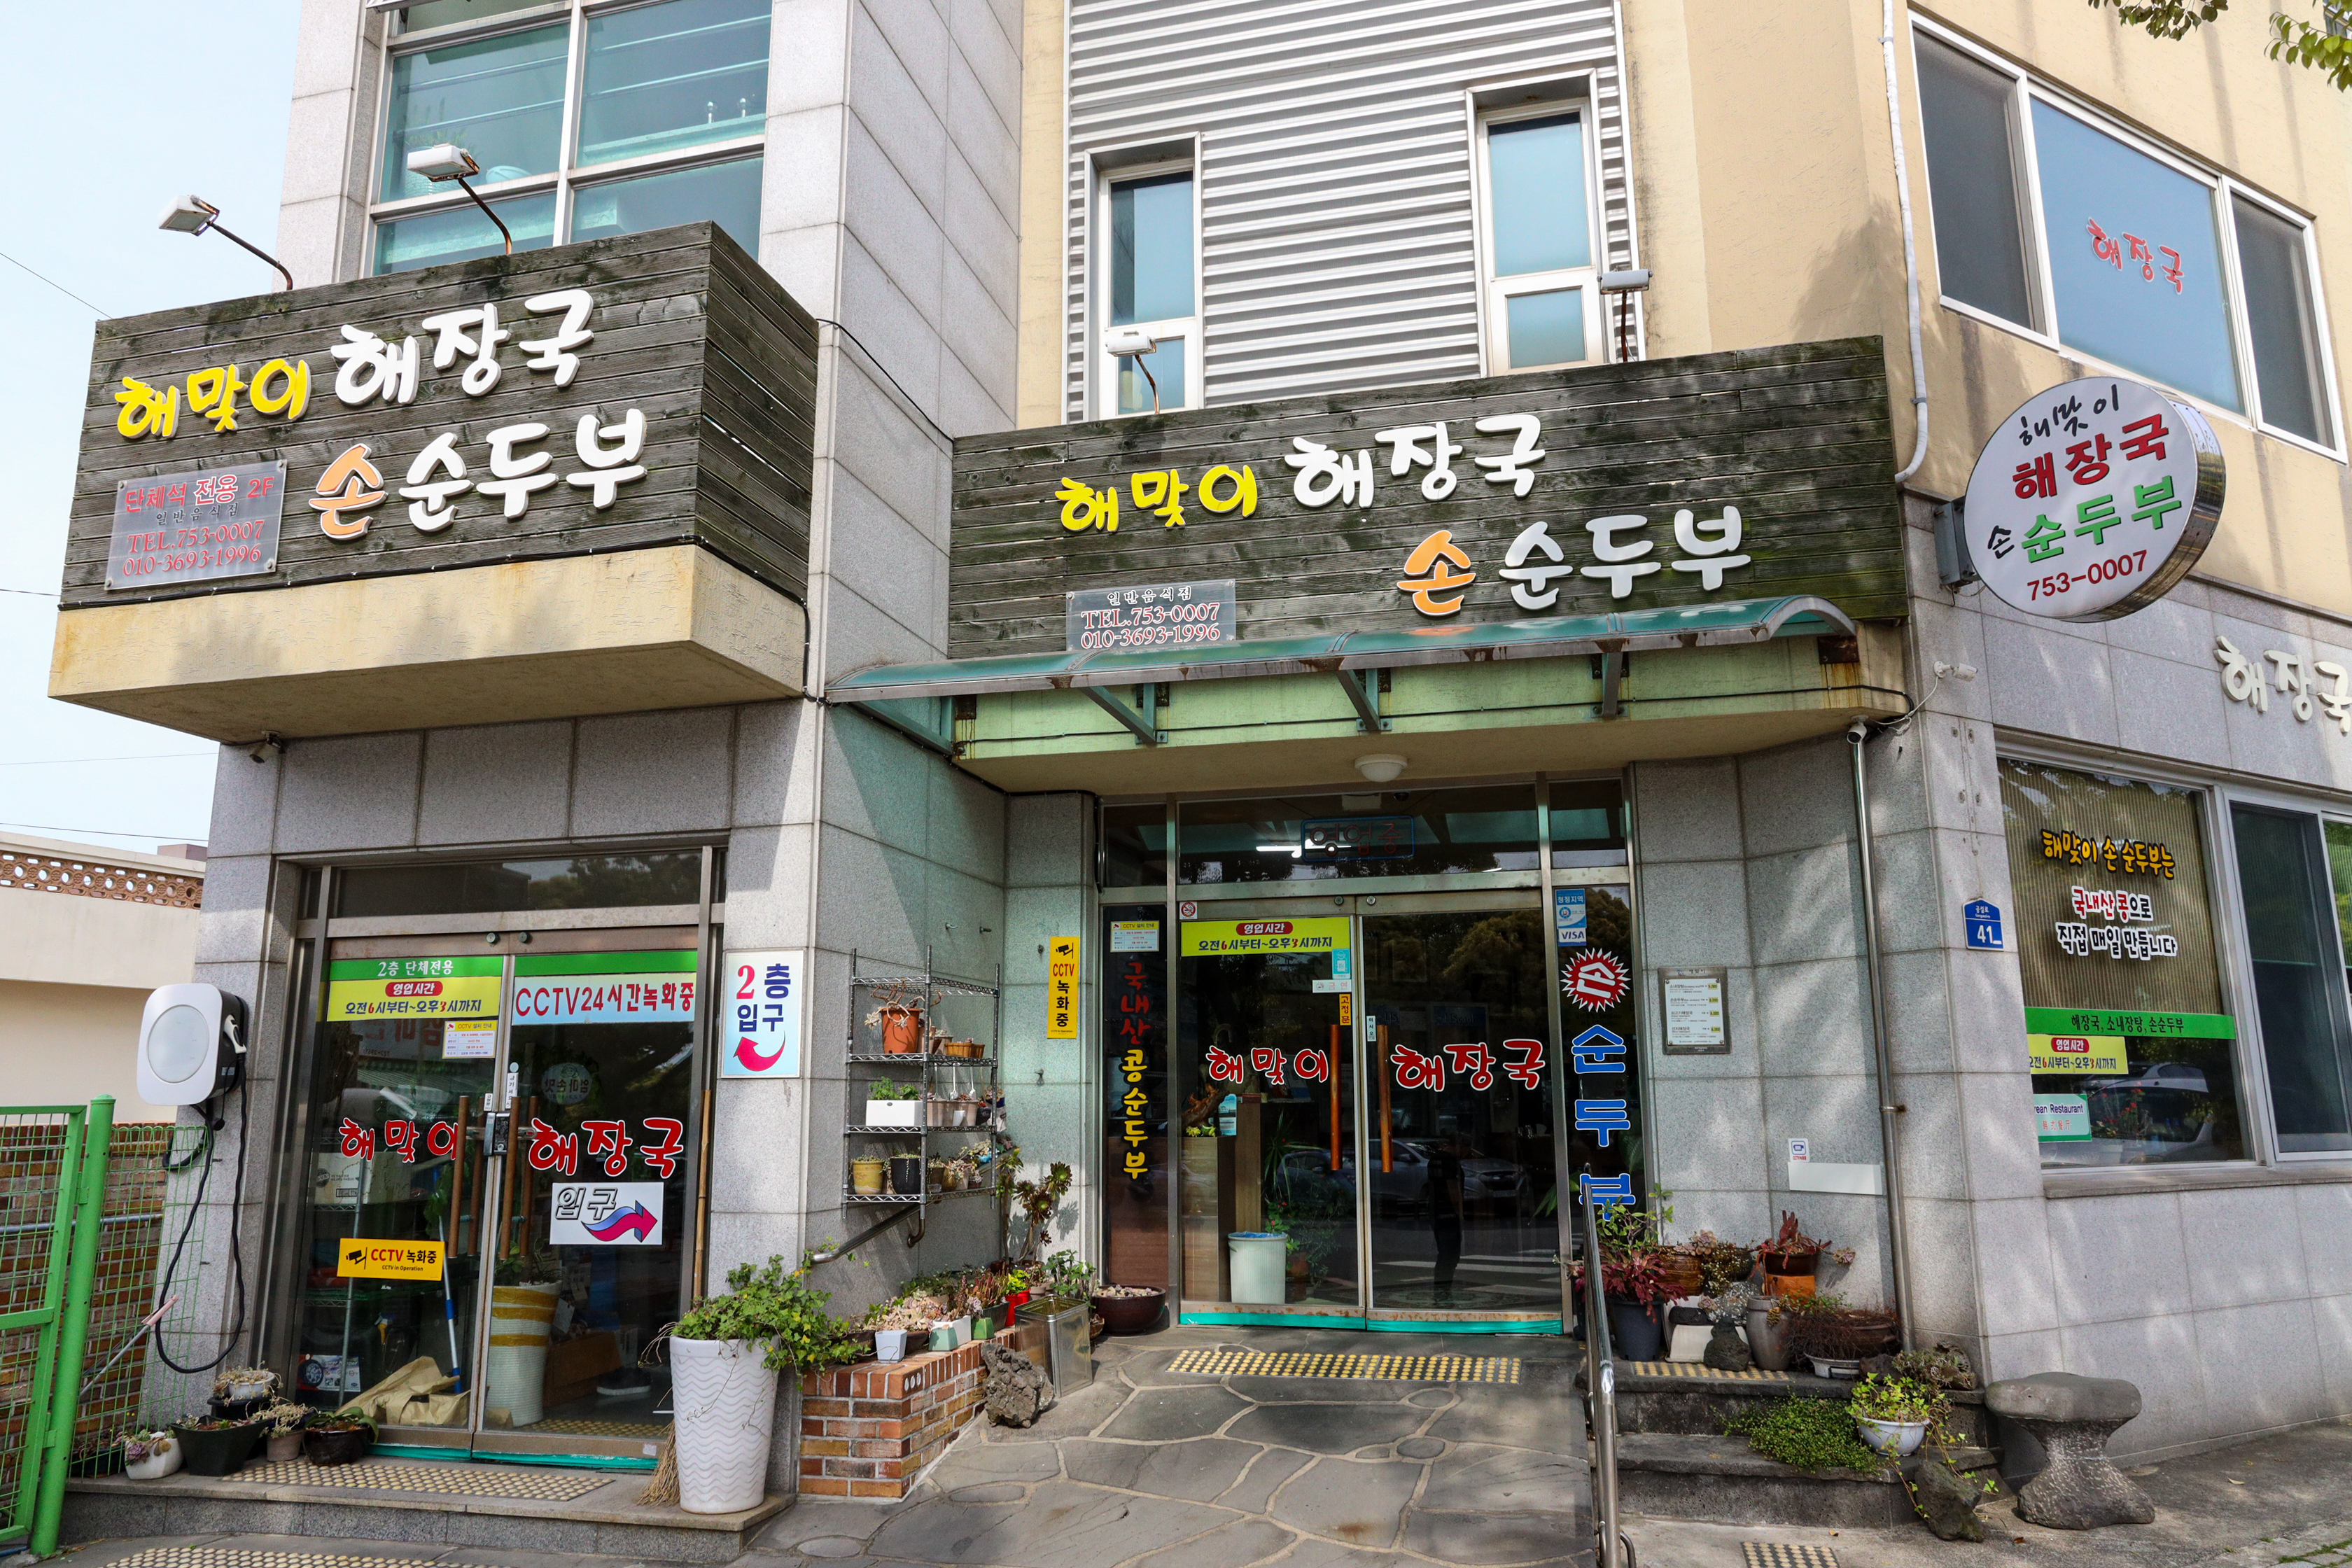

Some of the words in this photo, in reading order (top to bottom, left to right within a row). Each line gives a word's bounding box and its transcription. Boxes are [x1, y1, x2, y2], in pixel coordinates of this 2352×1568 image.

[2087, 216, 2185, 294] 해장국
[114, 358, 312, 440] 해맞이
[330, 288, 594, 406] 해장국
[1054, 463, 1258, 533] 해맞이
[1284, 414, 1546, 509] 해장국
[2012, 413, 2169, 500] 해장국
[308, 442, 388, 542] 손
[398, 408, 649, 533] 순두부
[125, 483, 187, 512] 단체석
[194, 475, 238, 505] 전용
[247, 477, 274, 498] 2F
[156, 502, 239, 525] 일반음식점
[1987, 525, 2015, 559] 손
[2021, 475, 2182, 564] 순두부
[127, 520, 265, 554] TEL.753-0007
[122, 543, 262, 576] 010-3693-1996
[1396, 528, 1476, 617] 손
[1498, 504, 1752, 611] 순두부
[2027, 549, 2148, 601] 753-0007
[1107, 585, 1193, 606] 일반음식점
[1081, 602, 1220, 630] TEL.753-0007
[1081, 622, 1220, 650] 010-3693-1996
[2213, 636, 2352, 735] 해장국
[1310, 822, 1404, 856] 영업중
[2040, 828, 2098, 866] 해맞이
[2102, 835, 2117, 873] 손
[2122, 839, 2175, 880] 순두부는
[1975, 905, 1989, 913] 공설로
[2071, 886, 2115, 920] 국내산
[2115, 890, 2153, 923] 콩으로
[1244, 923, 1284, 934] 영업시간
[1560, 931, 1585, 939] VISA
[1977, 925, 1994, 944] 41
[2056, 922, 2088, 955] 직접
[2090, 925, 2121, 958] 매일
[2122, 928, 2178, 960] 만듭니다
[378, 961, 399, 976] 2층
[405, 960, 454, 975] 단체전용
[735, 962, 792, 1001] 2층
[1053, 963, 1074, 976] CCTV
[1329, 981, 1348, 990] 금연
[1576, 961, 1616, 1000] 손
[393, 982, 435, 995] 영업시간
[1056, 980, 1070, 1027] 녹화중
[1120, 962, 1151, 1044] 국내산
[736, 1004, 784, 1032] 입구
[1341, 995, 1350, 1024] 고정문
[2071, 1014, 2104, 1032] 해장국,
[2149, 1017, 2184, 1033] 손순두부
[2056, 1039, 2085, 1051] 영업시간
[1205, 1045, 1329, 1085] 해맞이
[1390, 1038, 1546, 1092] 해장국
[1121, 1049, 1149, 1180] 콩순두부
[1571, 1024, 1636, 1222] 순두부
[2050, 1104, 2083, 1113] Restaurant
[338, 1118, 458, 1163] 해맞이
[528, 1118, 683, 1178] 해장국
[554, 1186, 617, 1221] 입구
[371, 1249, 404, 1261] CCTV
[407, 1250, 437, 1264] 녹화중
